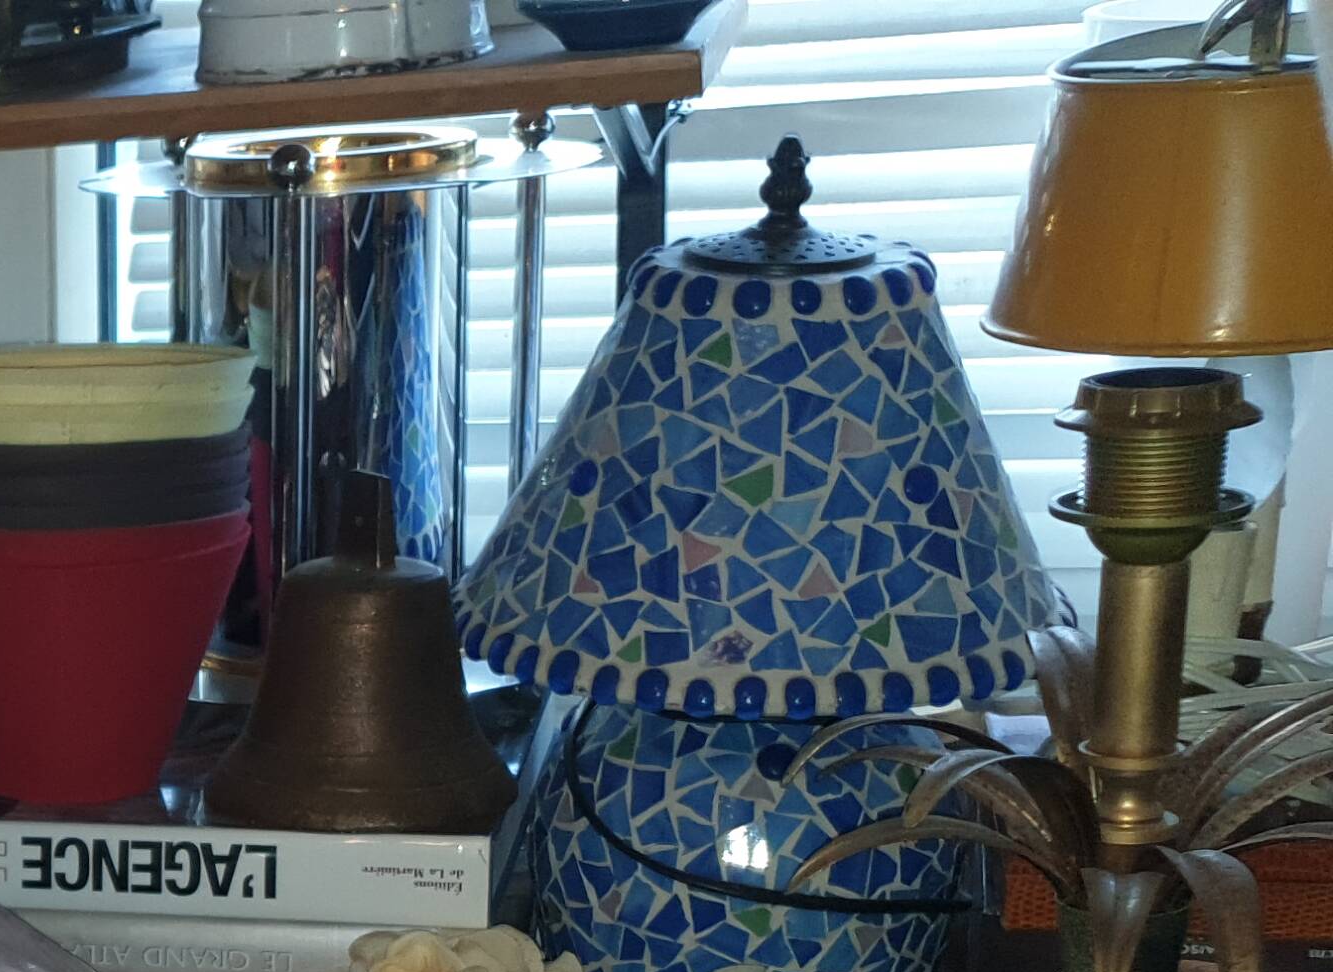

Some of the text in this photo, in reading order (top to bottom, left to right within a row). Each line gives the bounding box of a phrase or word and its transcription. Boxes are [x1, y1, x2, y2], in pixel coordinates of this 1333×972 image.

[21, 836, 277, 898] L'AGENCE
[362, 866, 464, 880] de La Martinière
[413, 881, 463, 896] Éditions
[142, 945, 250, 971] GRAND
[262, 951, 293, 972] LE
